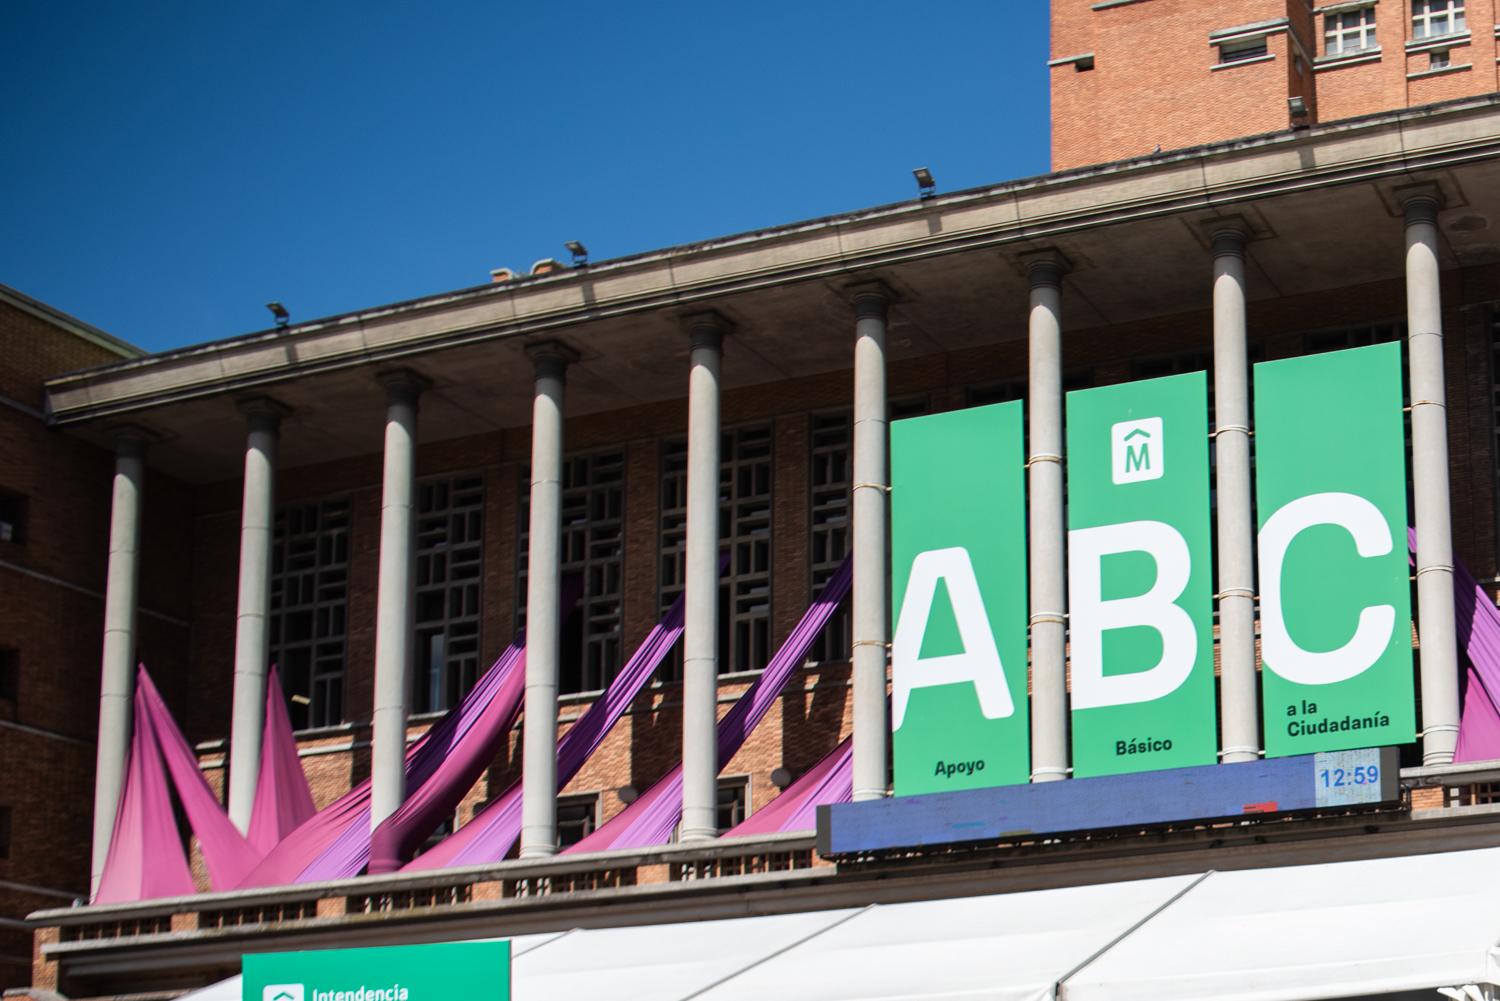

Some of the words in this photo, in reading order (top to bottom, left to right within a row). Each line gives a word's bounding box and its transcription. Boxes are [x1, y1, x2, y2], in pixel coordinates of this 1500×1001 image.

[1287, 706, 1297, 717] a
[1302, 700, 1317, 715] la
[1287, 712, 1390, 737] Ciudadanía
[1116, 737, 1173, 756] Básico
[935, 760, 985, 779] Apoyo
[1320, 766, 1379, 788] 12:59
